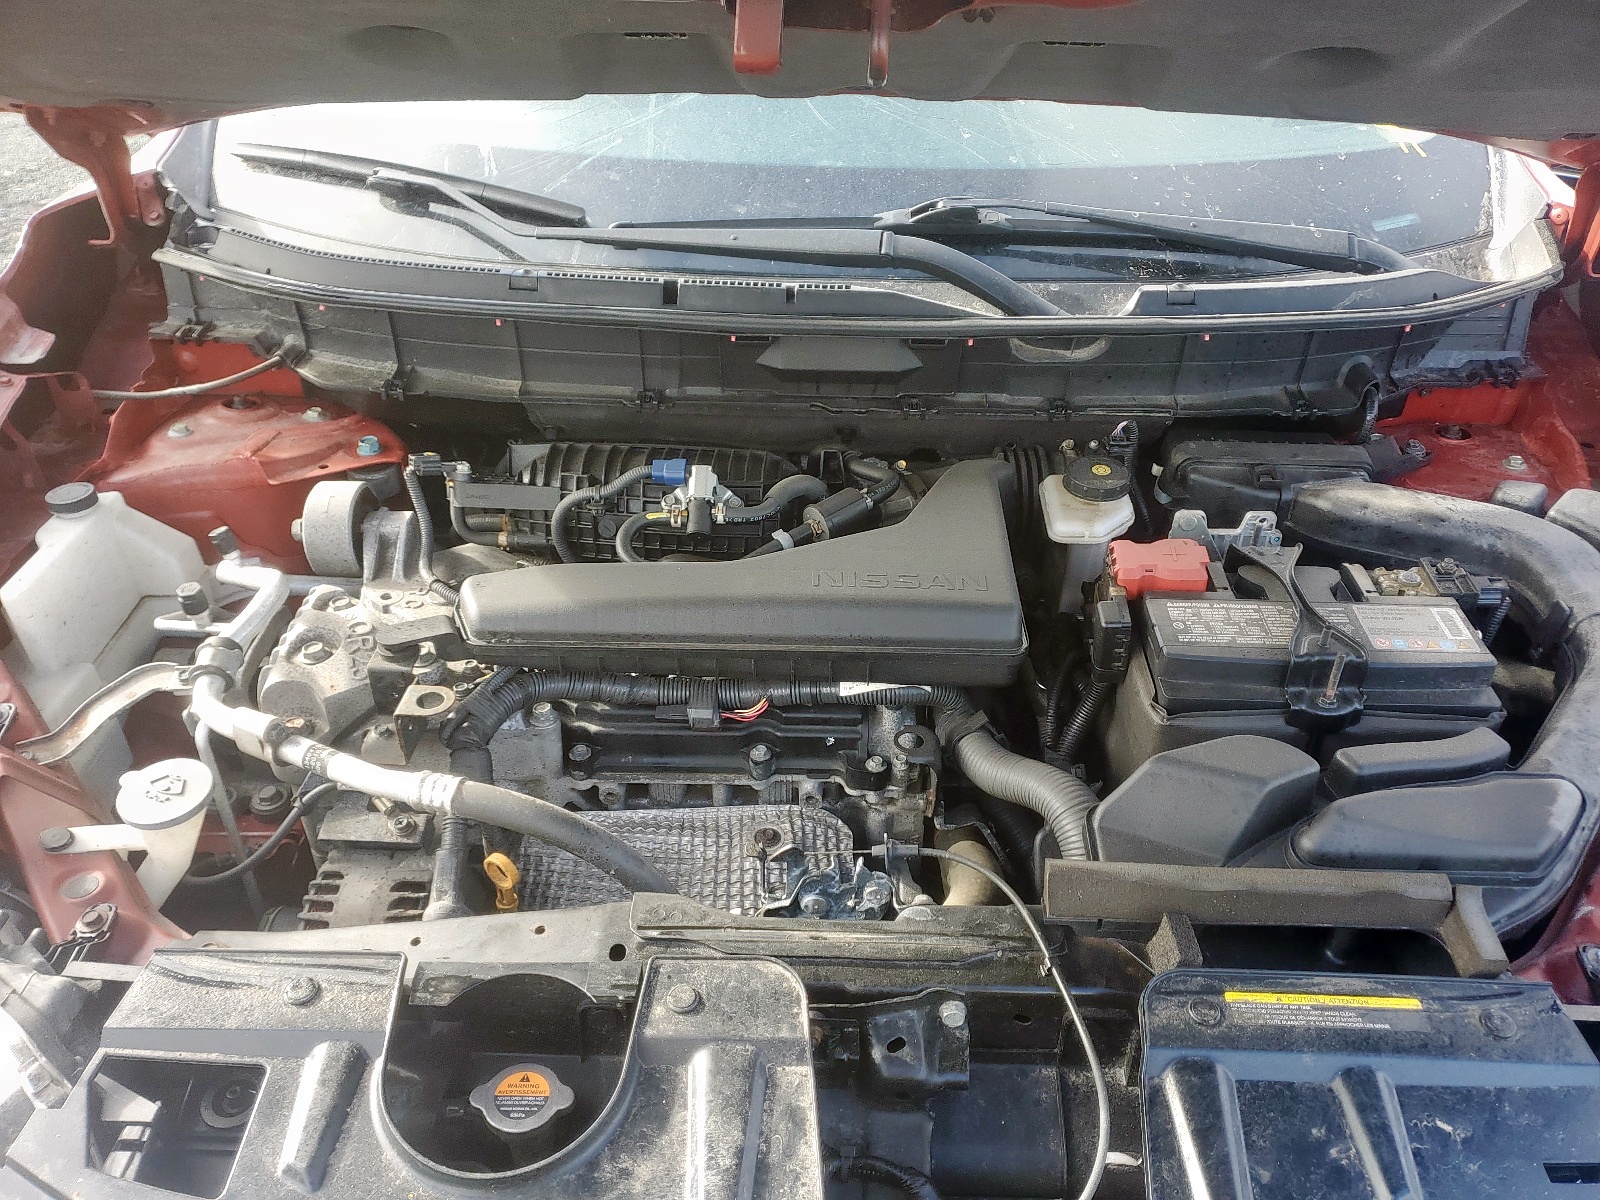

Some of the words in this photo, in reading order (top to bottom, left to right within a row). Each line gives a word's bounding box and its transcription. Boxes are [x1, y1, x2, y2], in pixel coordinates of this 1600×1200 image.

[811, 570, 989, 592] NISSAN
[1287, 996, 1321, 1004] CAUTION
[1328, 997, 1370, 1006] ATTENTION
